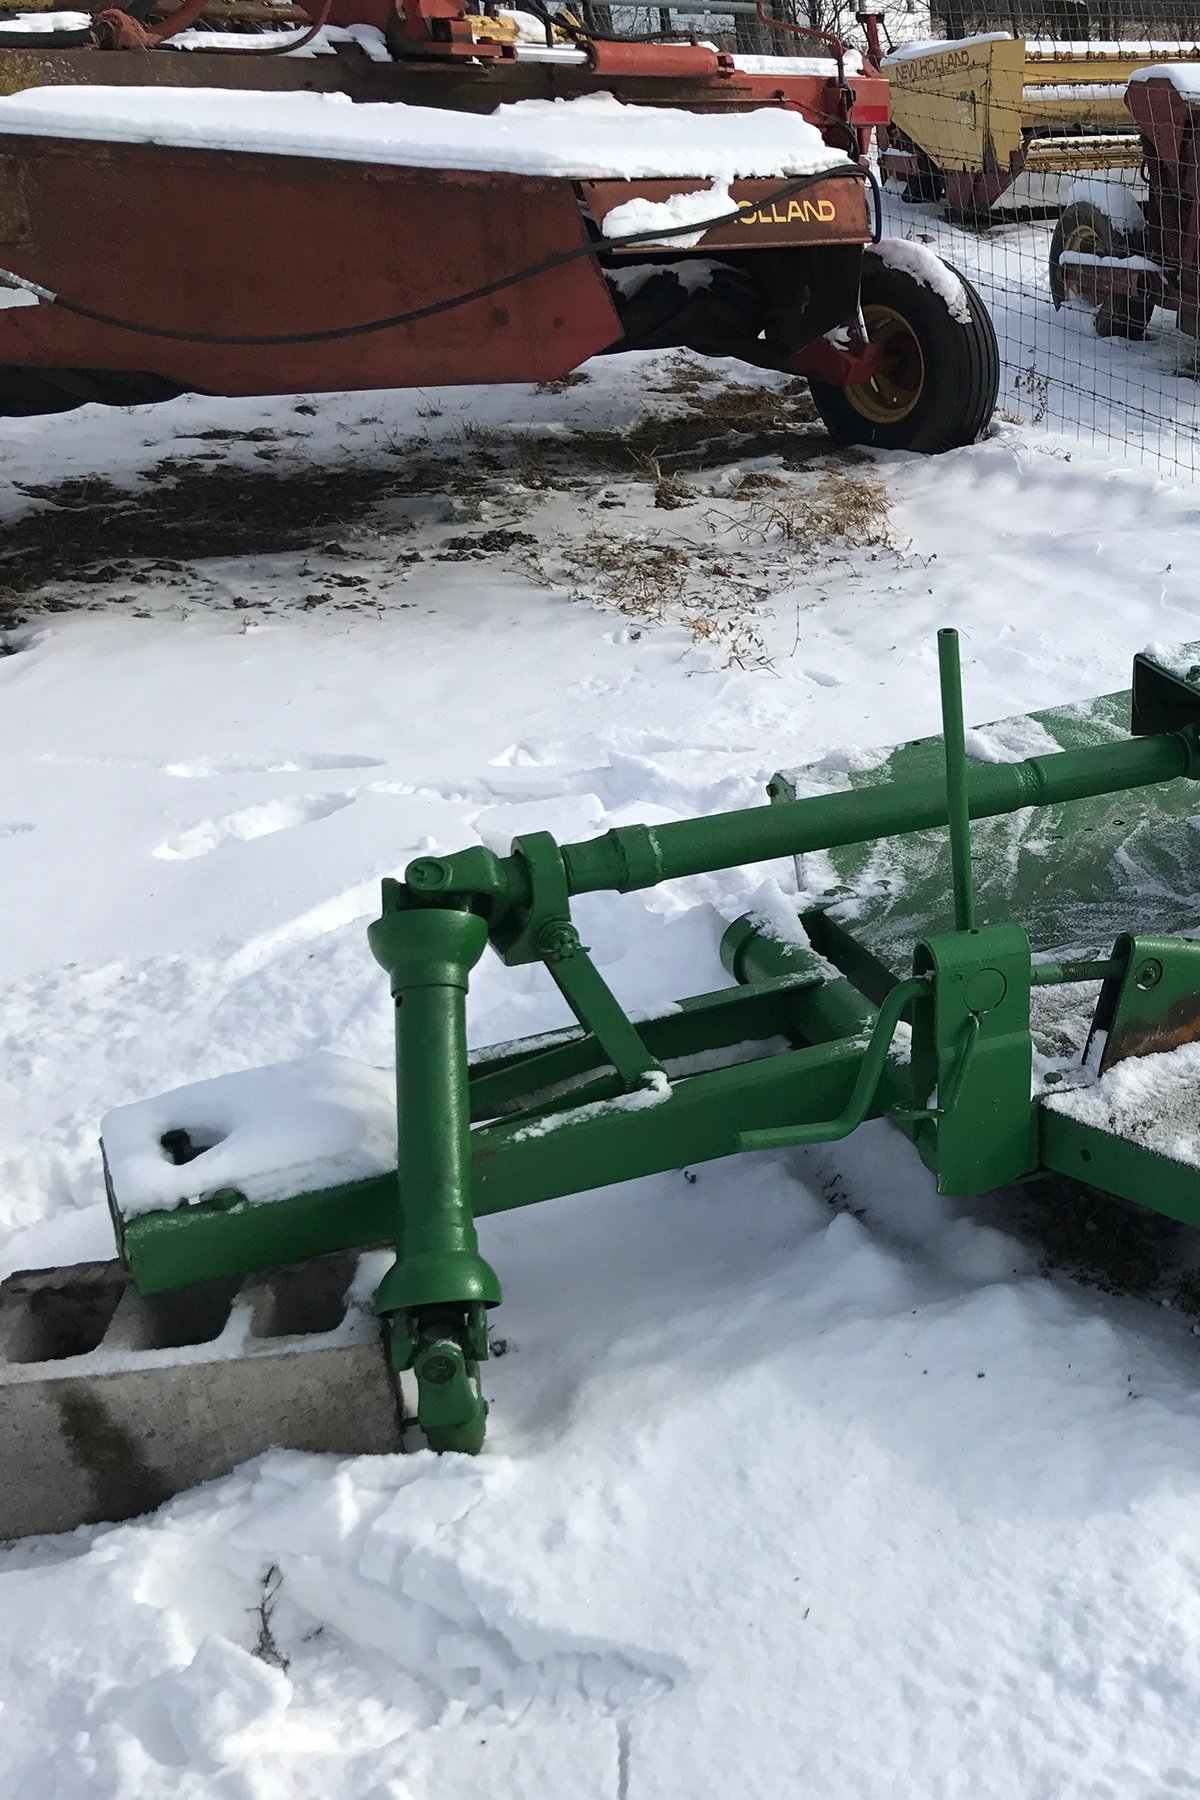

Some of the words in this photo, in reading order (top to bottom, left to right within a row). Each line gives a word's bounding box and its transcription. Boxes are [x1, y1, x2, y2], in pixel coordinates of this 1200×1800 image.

[895, 63, 918, 80] NEW
[920, 50, 970, 75] HOLLAND
[733, 199, 836, 225] OLLAND
